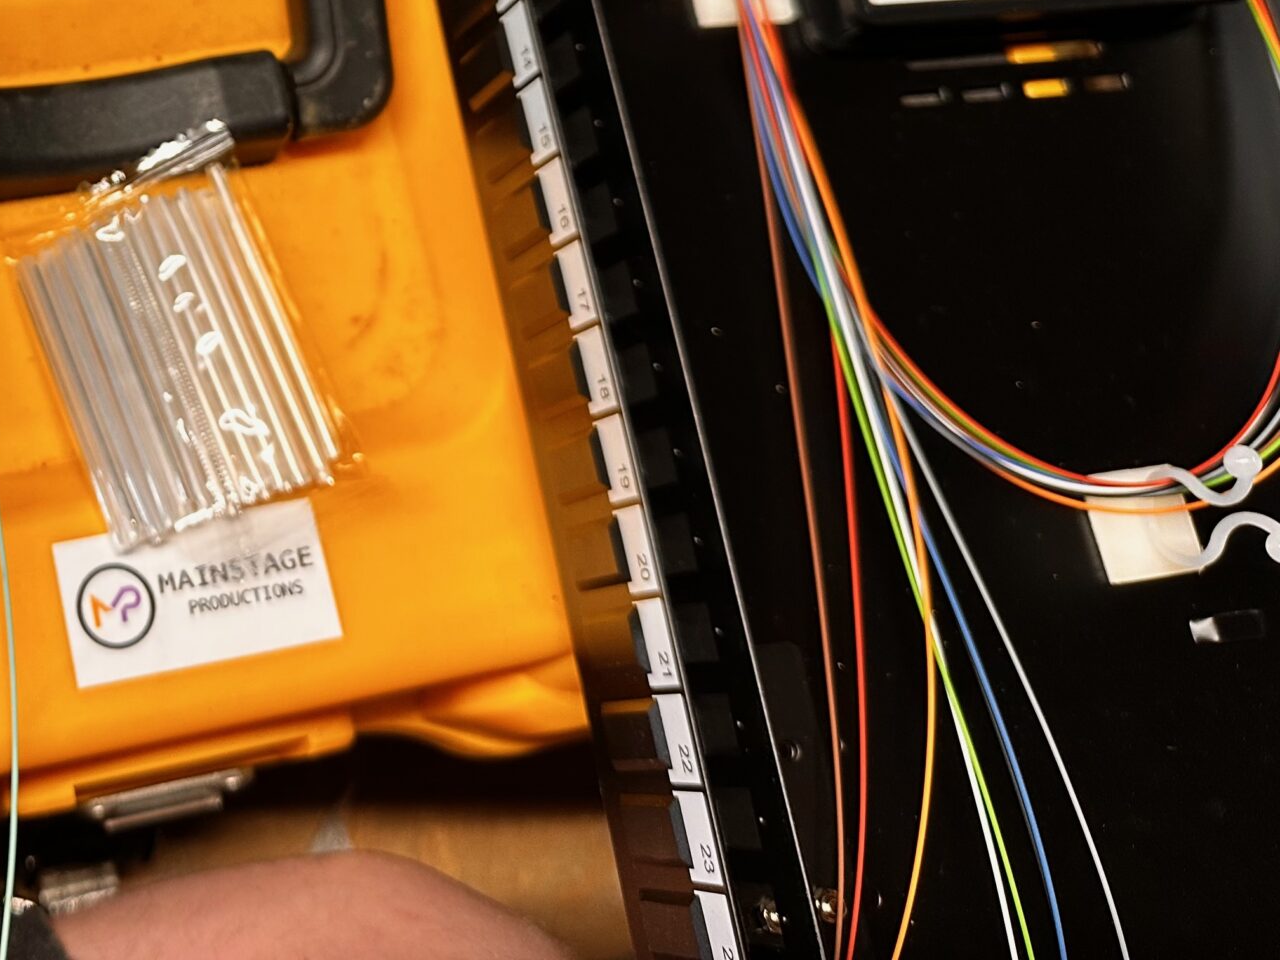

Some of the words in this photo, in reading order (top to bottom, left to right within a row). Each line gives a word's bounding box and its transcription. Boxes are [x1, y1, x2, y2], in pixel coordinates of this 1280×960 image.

[537, 124, 552, 149] 15
[557, 203, 570, 230] 16
[577, 290, 591, 312] 17
[597, 376, 610, 401] 18
[617, 463, 631, 489] 19
[156, 545, 313, 594] MAINSTAGE
[636, 552, 651, 582] 20
[187, 579, 305, 616] PRODUCTIONS
[657, 651, 673, 678] 21
[678, 743, 694, 775] 22
[700, 843, 716, 875] 23
